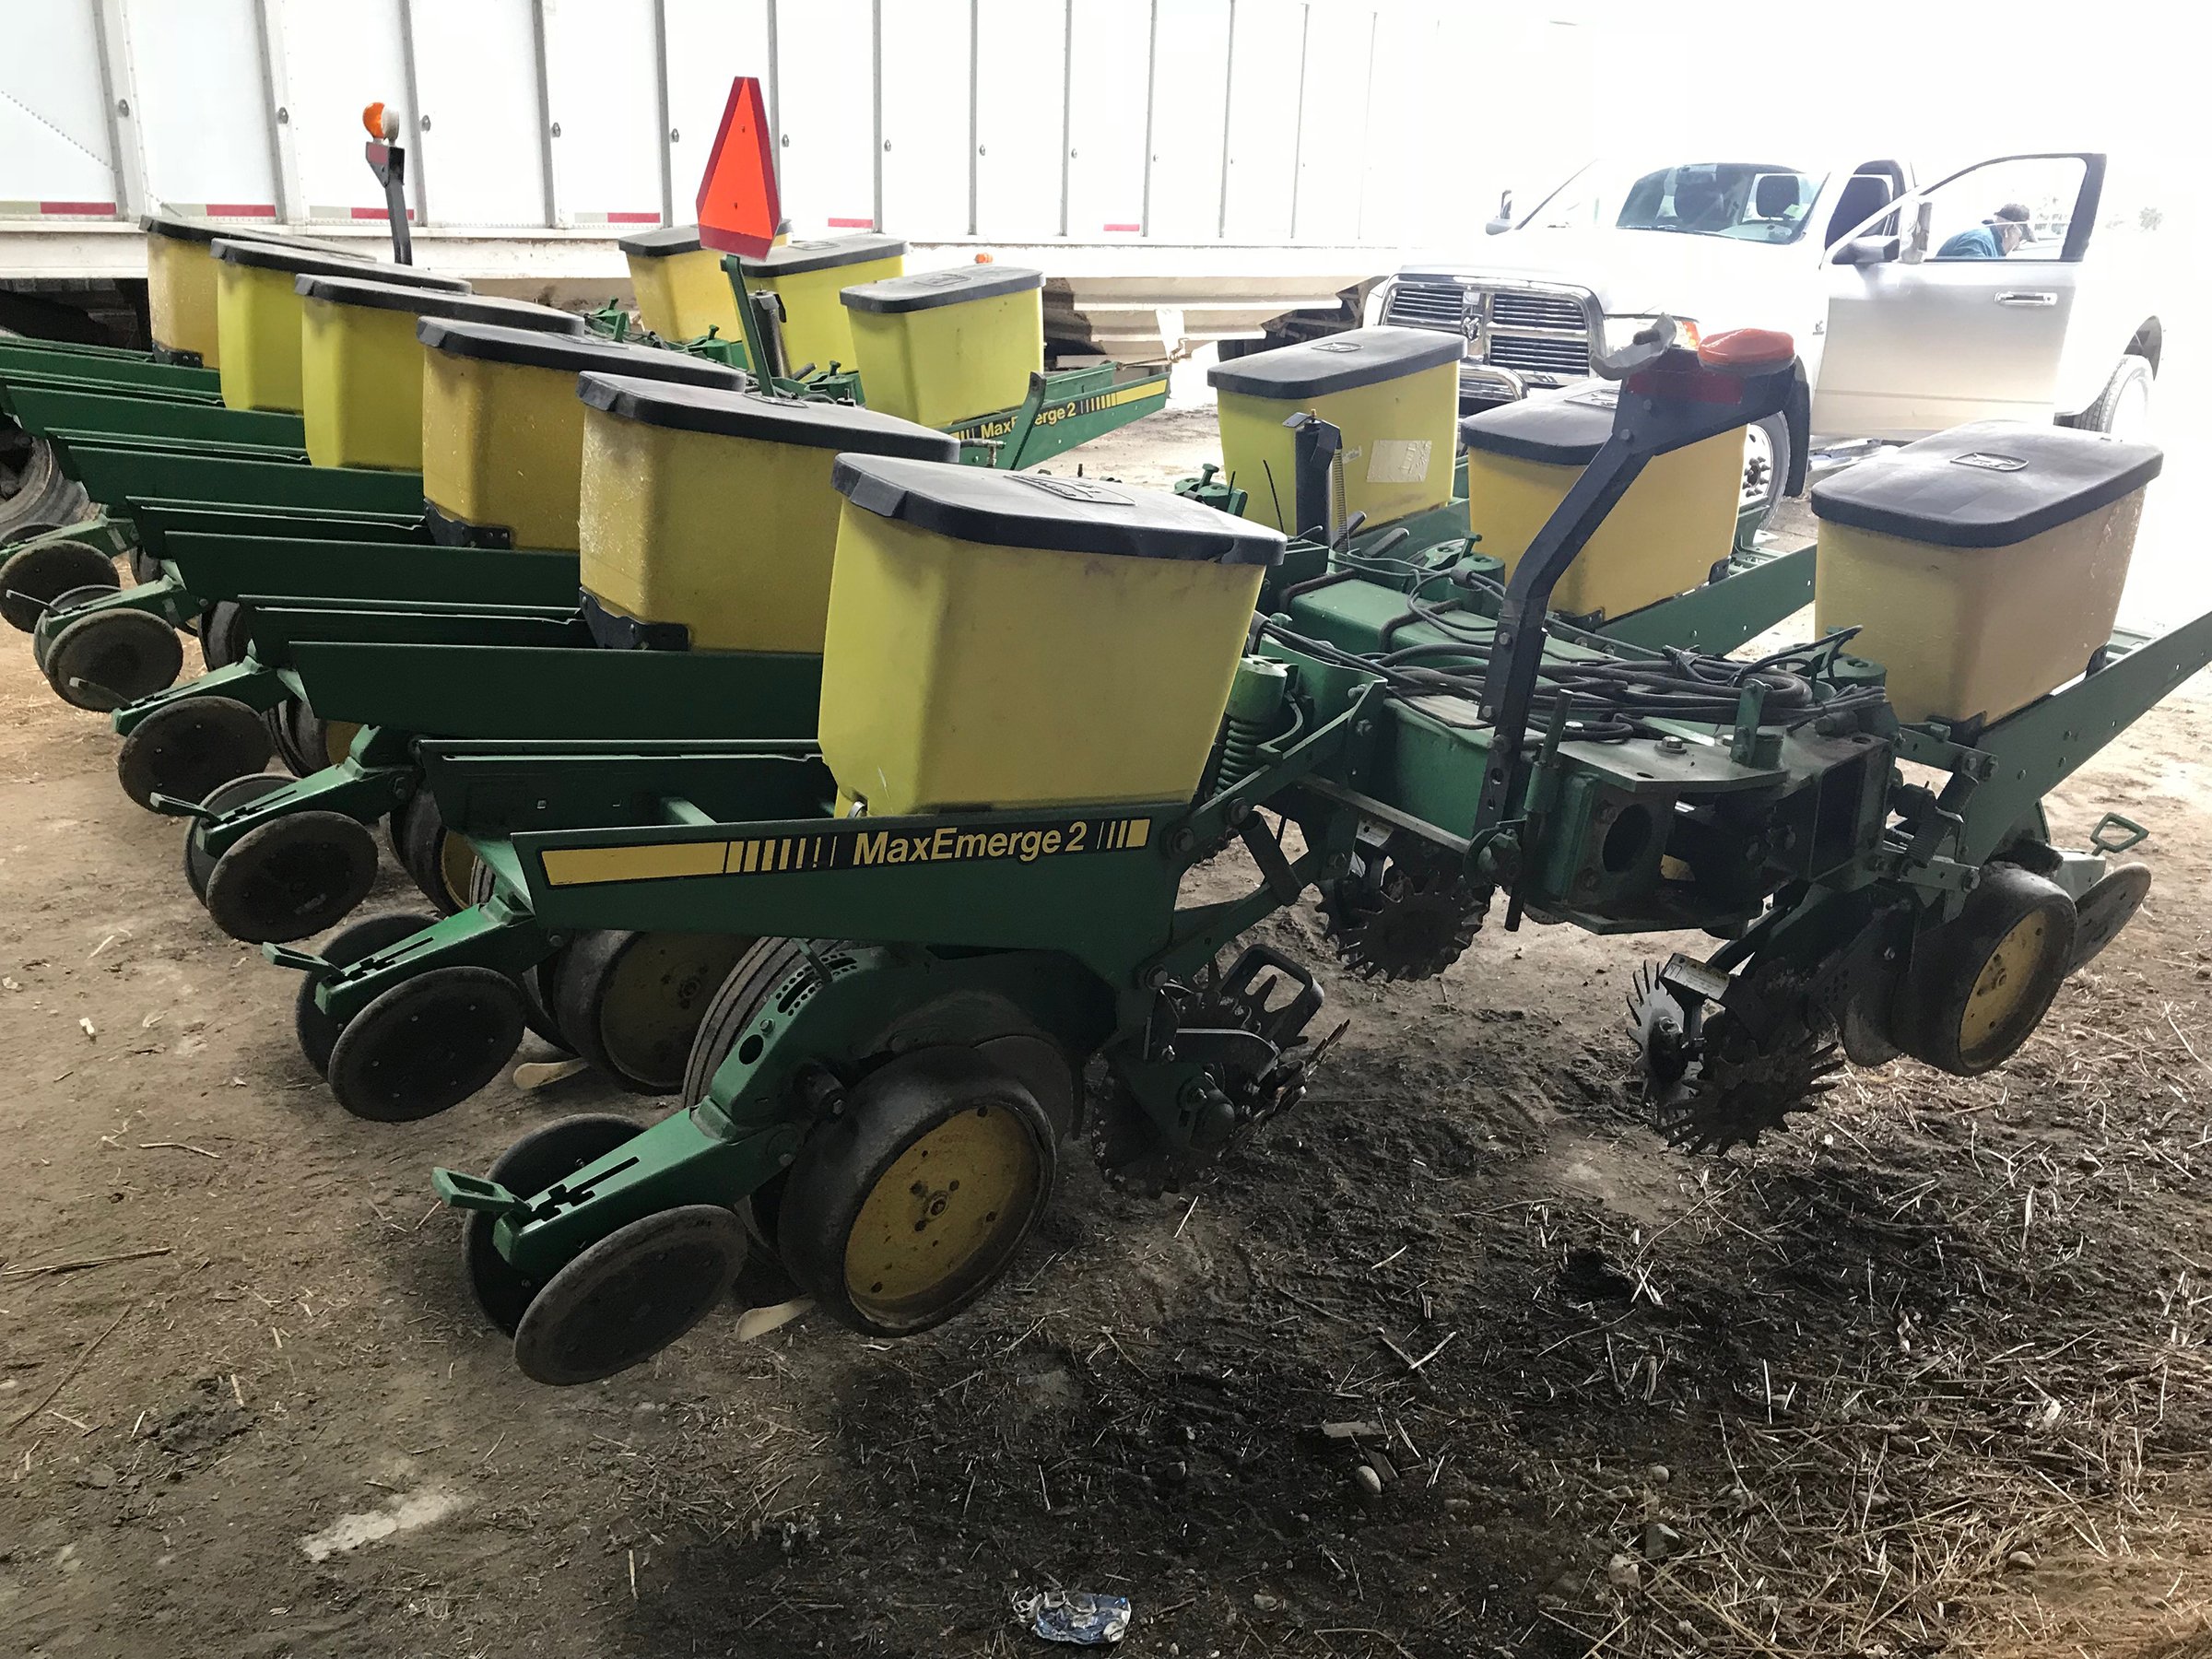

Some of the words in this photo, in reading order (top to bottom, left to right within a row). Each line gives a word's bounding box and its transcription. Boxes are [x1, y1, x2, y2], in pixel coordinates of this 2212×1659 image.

[981, 408, 1065, 439] Maxerge
[1067, 402, 1077, 417] 2
[853, 828, 1061, 865] MaxEmerge
[1065, 821, 1088, 852] 2
